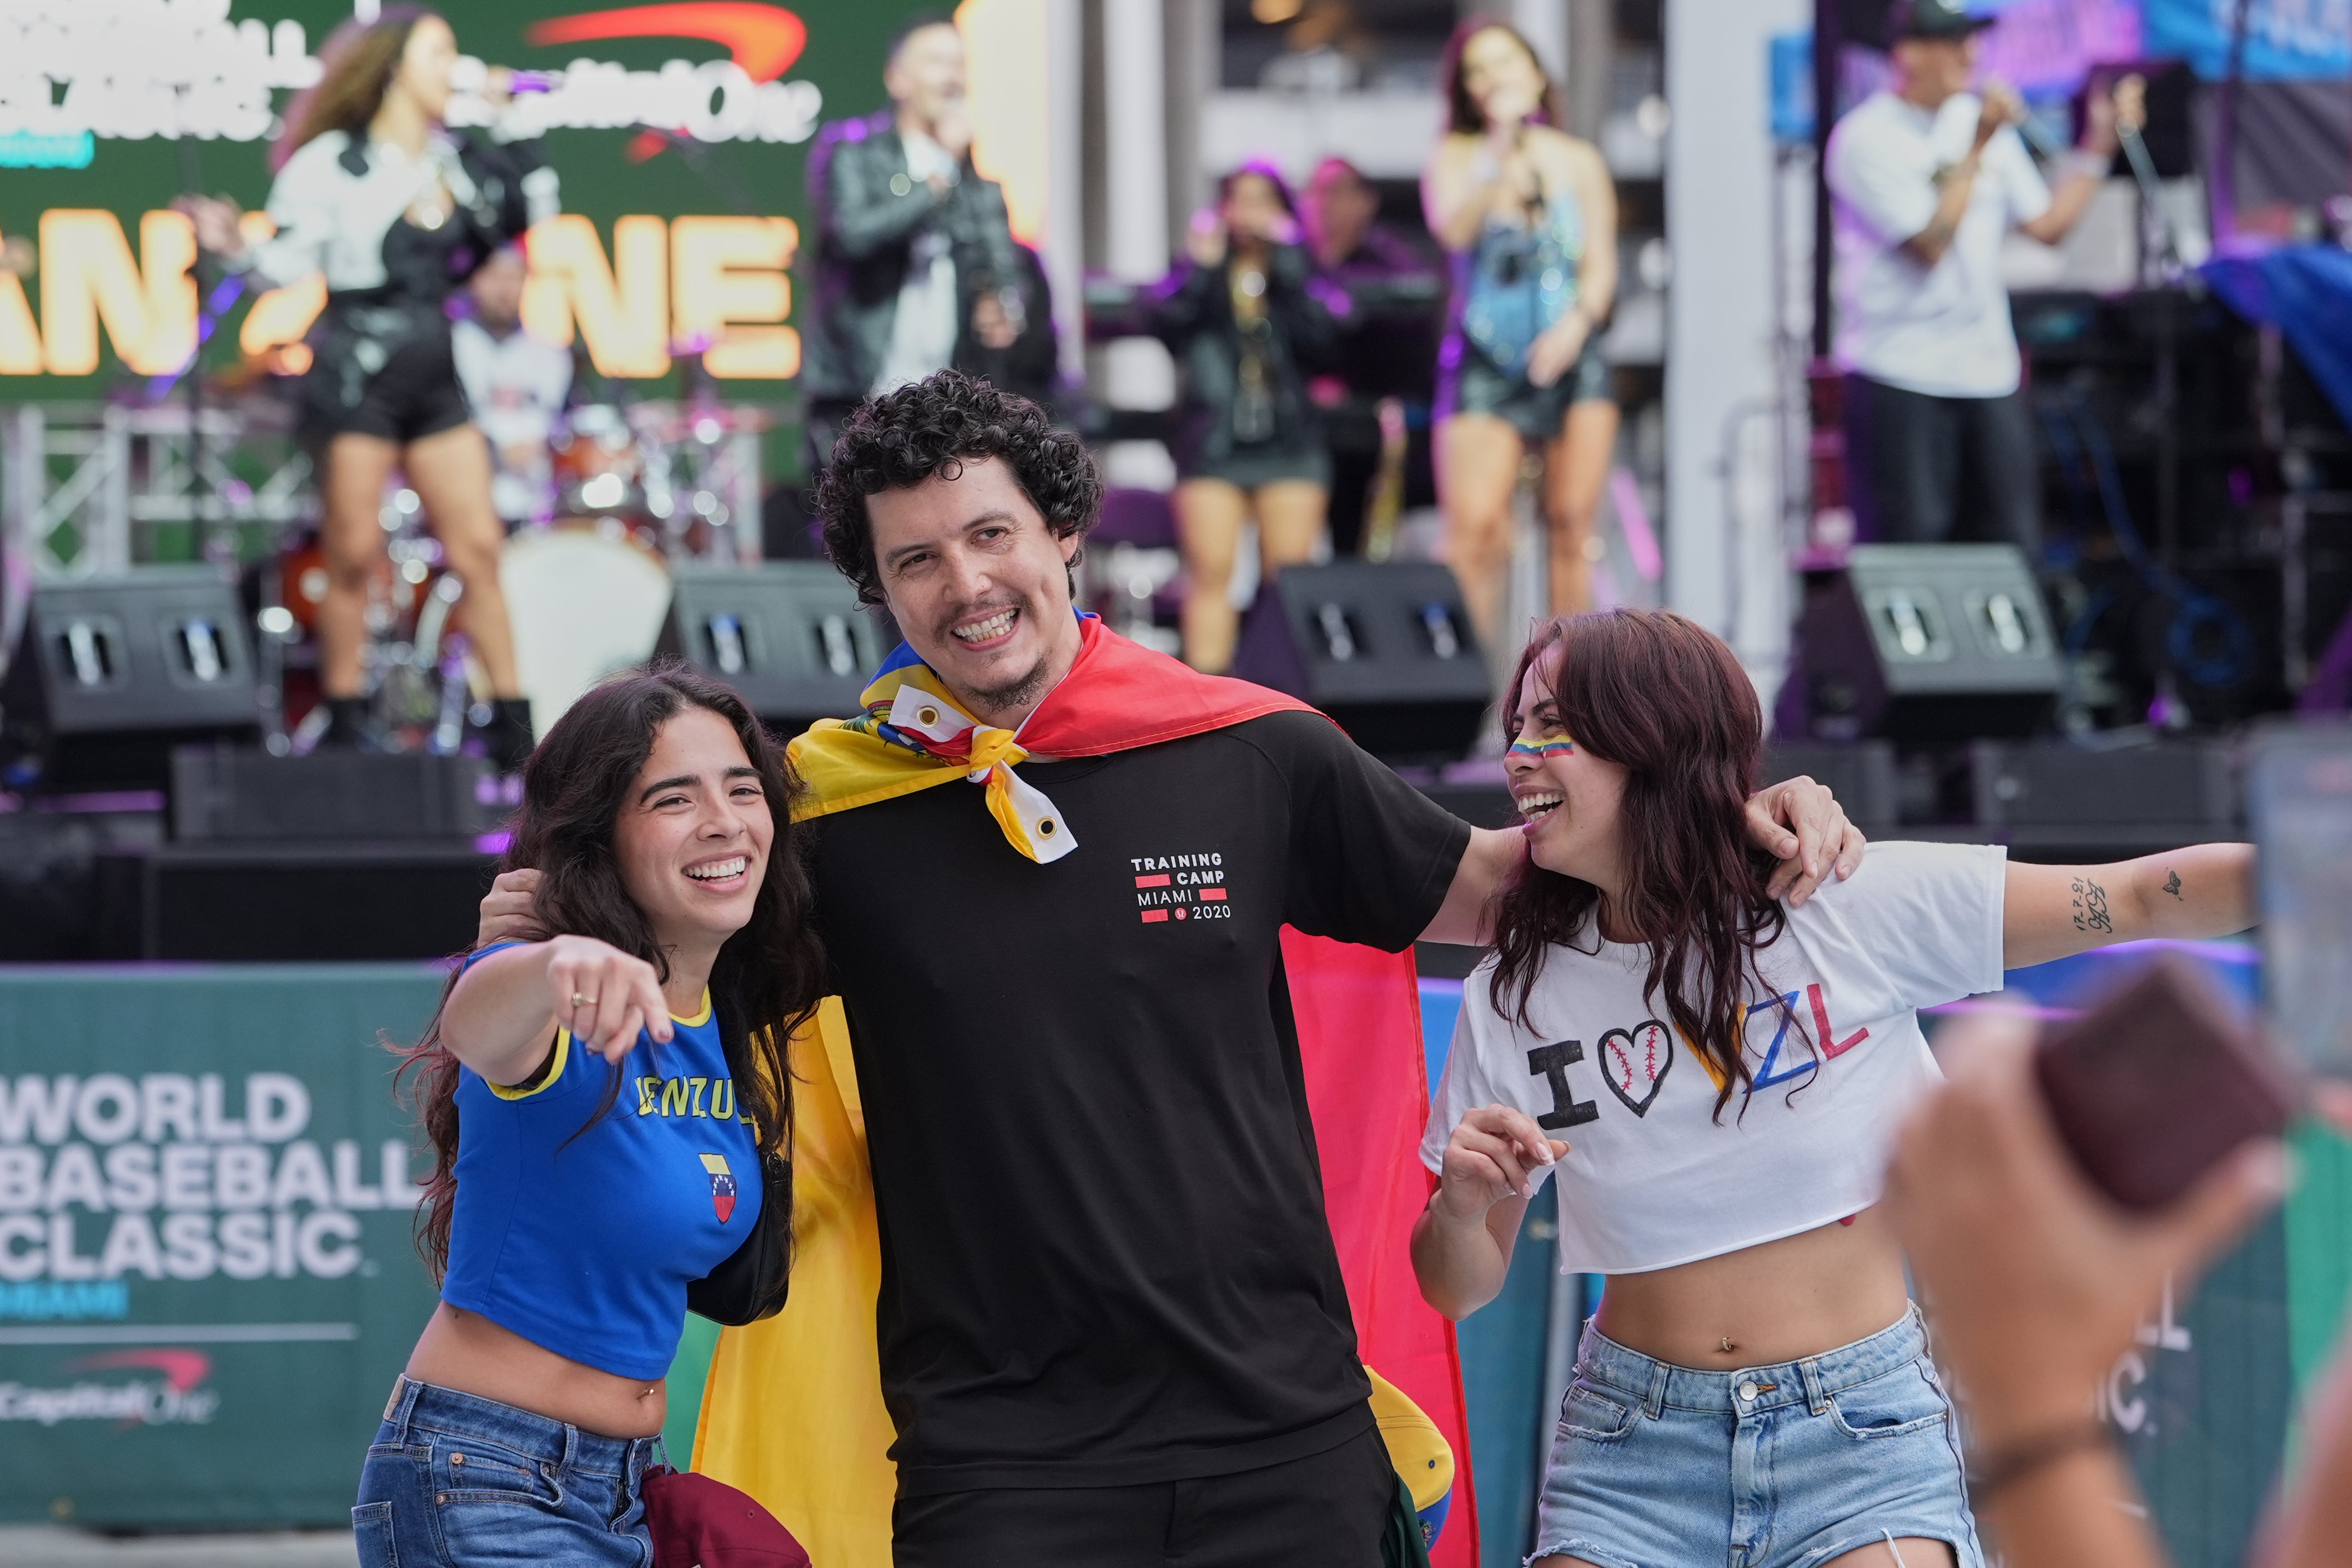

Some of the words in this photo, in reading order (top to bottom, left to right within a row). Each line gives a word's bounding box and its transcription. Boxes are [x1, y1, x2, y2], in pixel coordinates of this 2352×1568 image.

[1130, 852, 1223, 872] TRAINING
[1177, 870, 1224, 886] CAMP
[1137, 889, 1193, 906] MIAMI
[1193, 905, 1231, 919] 2020
[1527, 1040, 1599, 1130] I
[0, 1072, 311, 1145] WORLD
[0, 1139, 429, 1213] BASEBALL
[0, 1209, 362, 1280] CLASSIC
